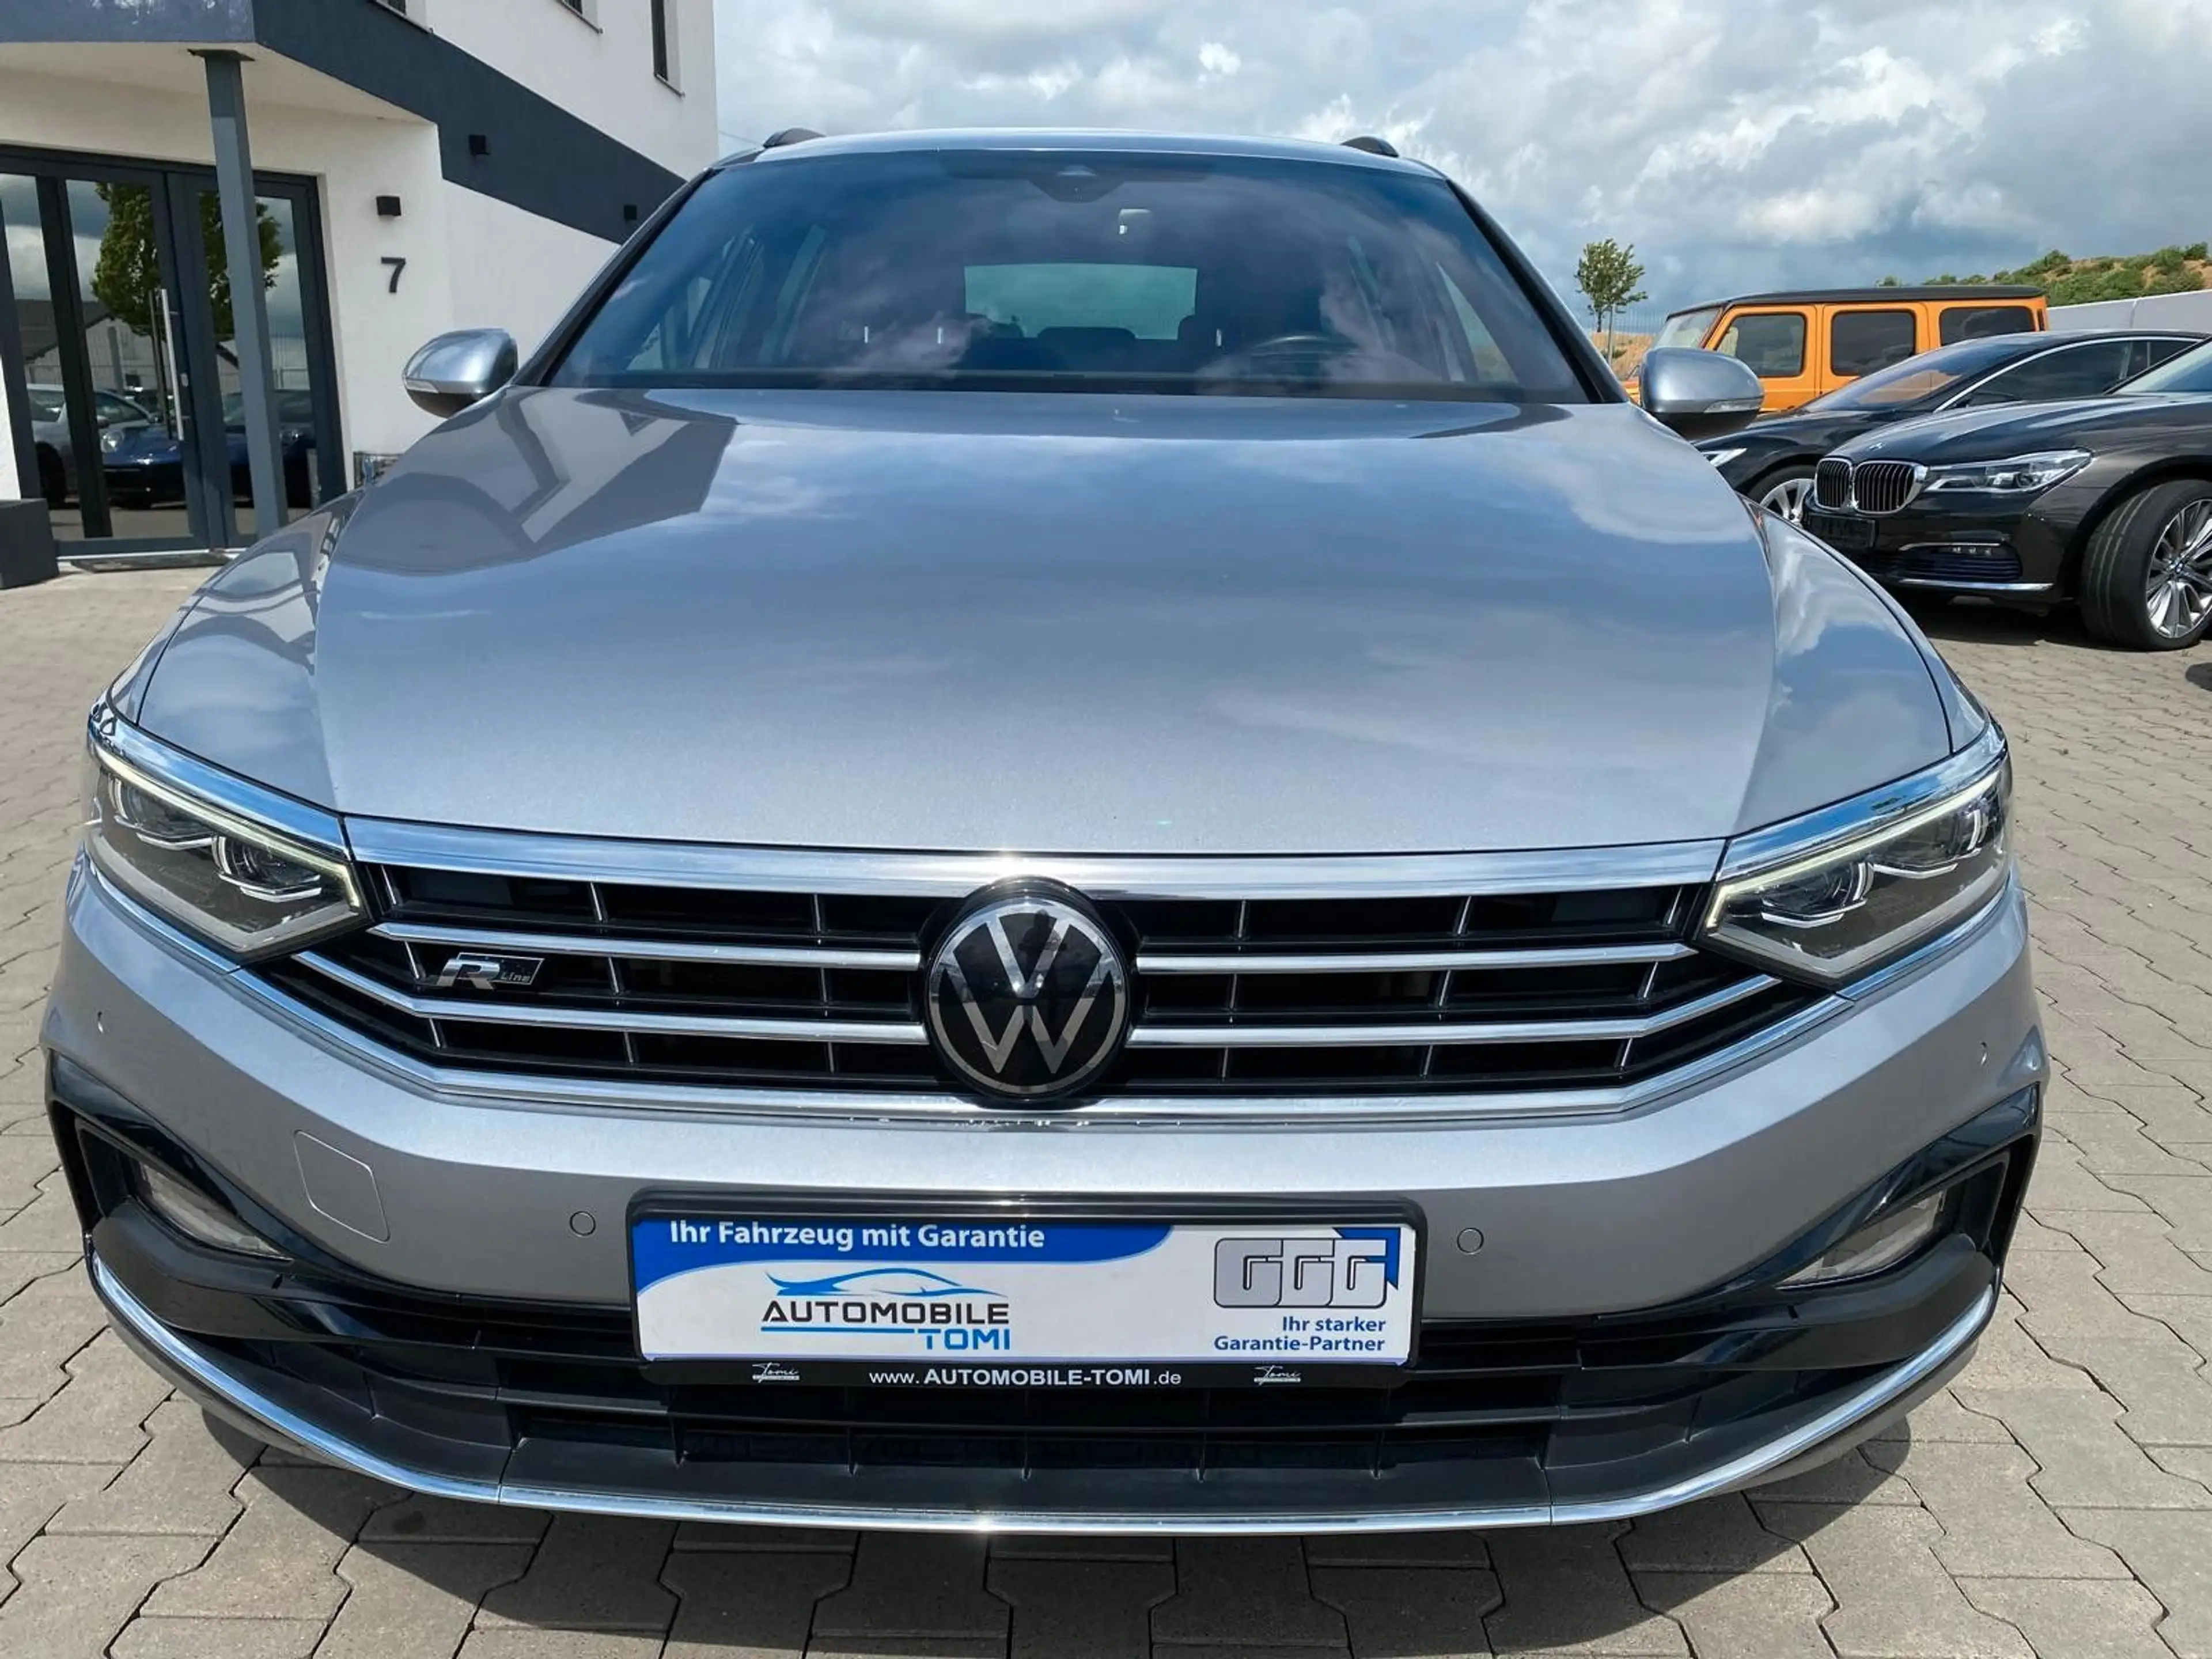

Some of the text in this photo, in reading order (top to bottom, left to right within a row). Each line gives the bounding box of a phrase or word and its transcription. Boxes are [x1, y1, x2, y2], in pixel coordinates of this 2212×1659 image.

[381, 257, 406, 294] 7
[437, 959, 500, 991] R
[670, 1219, 1045, 1251] Ihr Fahrzeug mit Garantie
[762, 1300, 1009, 1324] AUTOMOBILE
[1282, 1316, 1387, 1332] Ihr starker
[917, 1328, 1010, 1350] TOMI
[1214, 1335, 1385, 1351] Garantie-Partner
